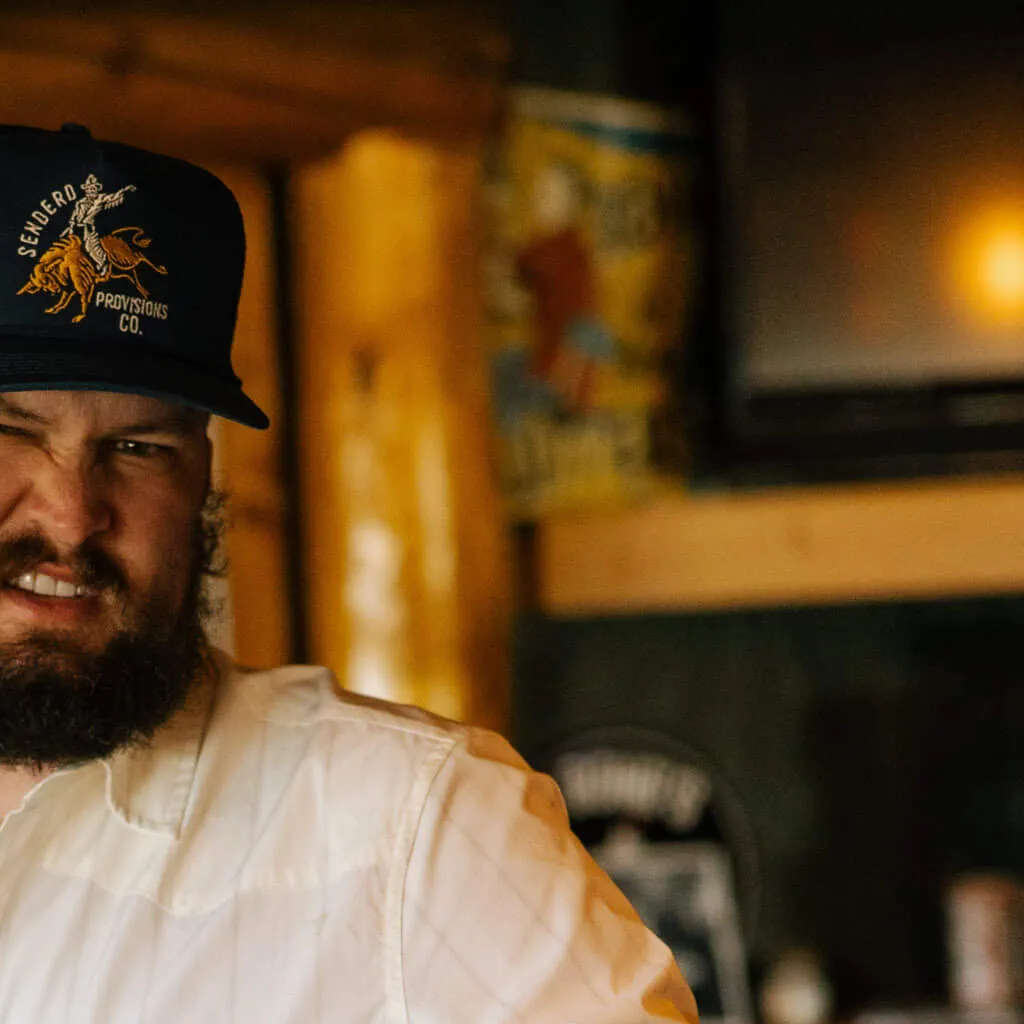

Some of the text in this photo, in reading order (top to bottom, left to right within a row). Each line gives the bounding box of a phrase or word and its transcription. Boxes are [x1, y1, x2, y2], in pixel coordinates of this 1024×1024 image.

[17, 184, 77, 258] SENDERO
[95, 291, 169, 320] PROVISIONS
[119, 313, 143, 335] CO.
